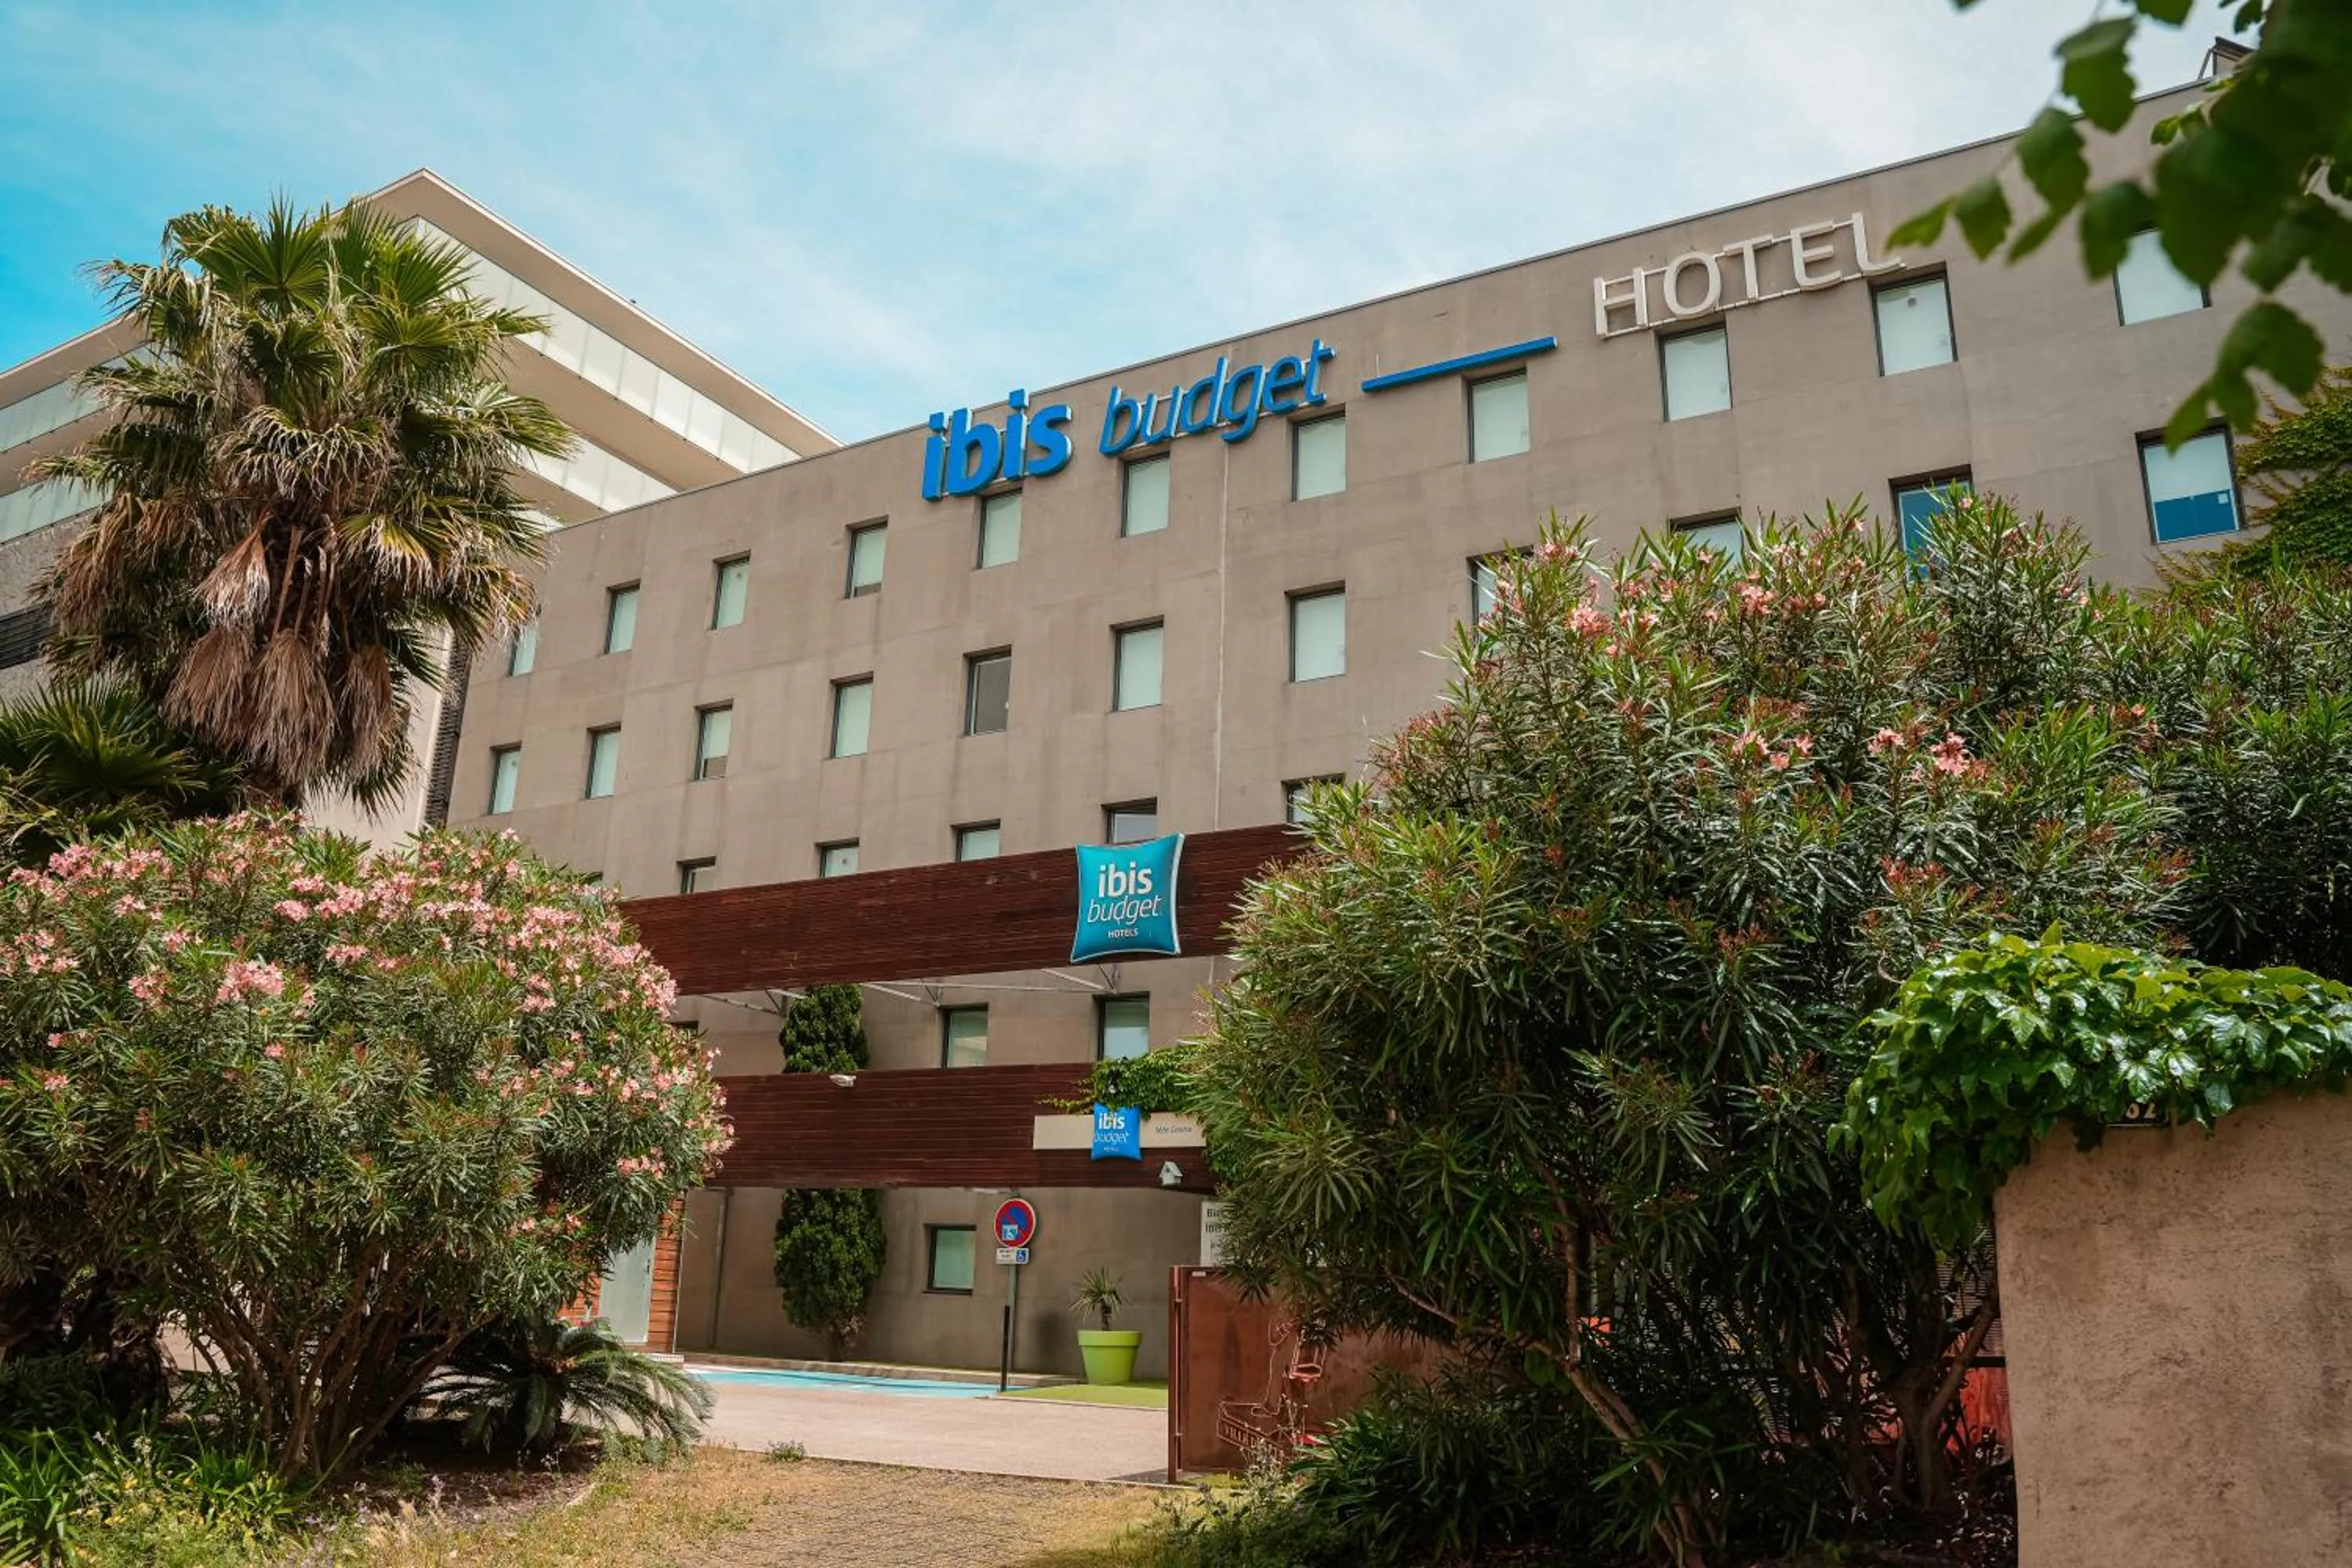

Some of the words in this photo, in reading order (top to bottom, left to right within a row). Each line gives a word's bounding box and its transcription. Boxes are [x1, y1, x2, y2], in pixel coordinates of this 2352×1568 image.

[1592, 212, 1907, 339] HOTEL
[922, 388, 1072, 502] ibis
[1099, 338, 1336, 456] budget
[1098, 861, 1152, 898] ibis
[1087, 895, 1163, 925] budget
[1108, 927, 1139, 938] HOTELS
[1098, 1112, 1126, 1130] ibis
